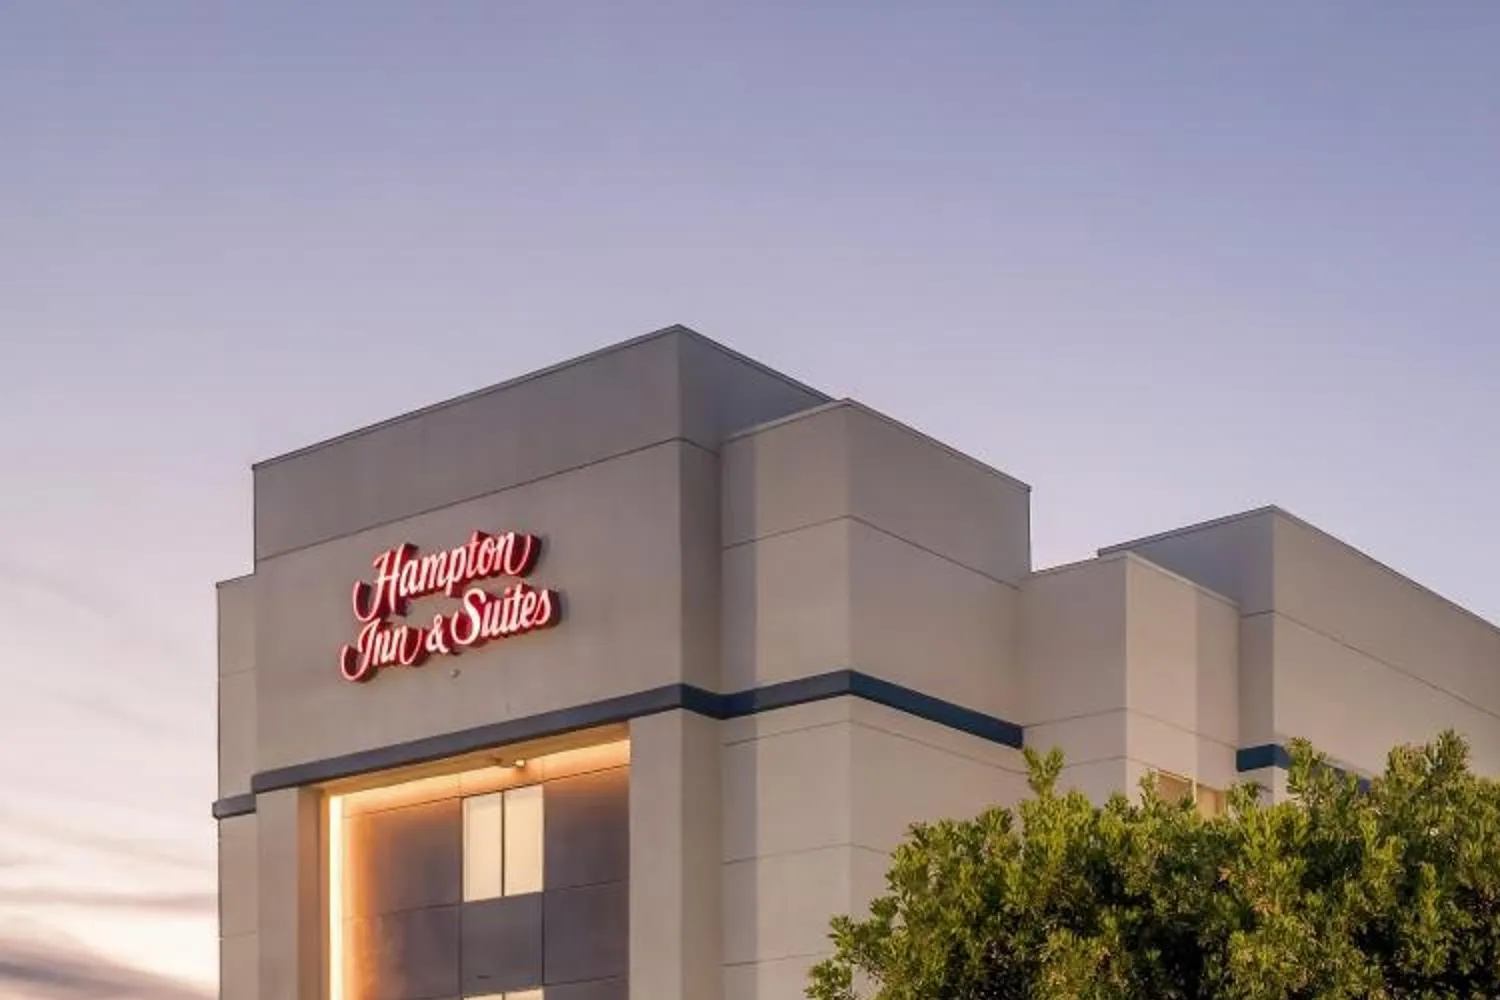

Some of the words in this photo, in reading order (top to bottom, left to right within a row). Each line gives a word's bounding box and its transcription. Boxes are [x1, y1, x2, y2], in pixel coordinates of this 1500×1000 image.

[353, 530, 538, 622] Hampton
[341, 617, 424, 681] Inn
[426, 613, 453, 655] &
[451, 583, 557, 647] Suites
